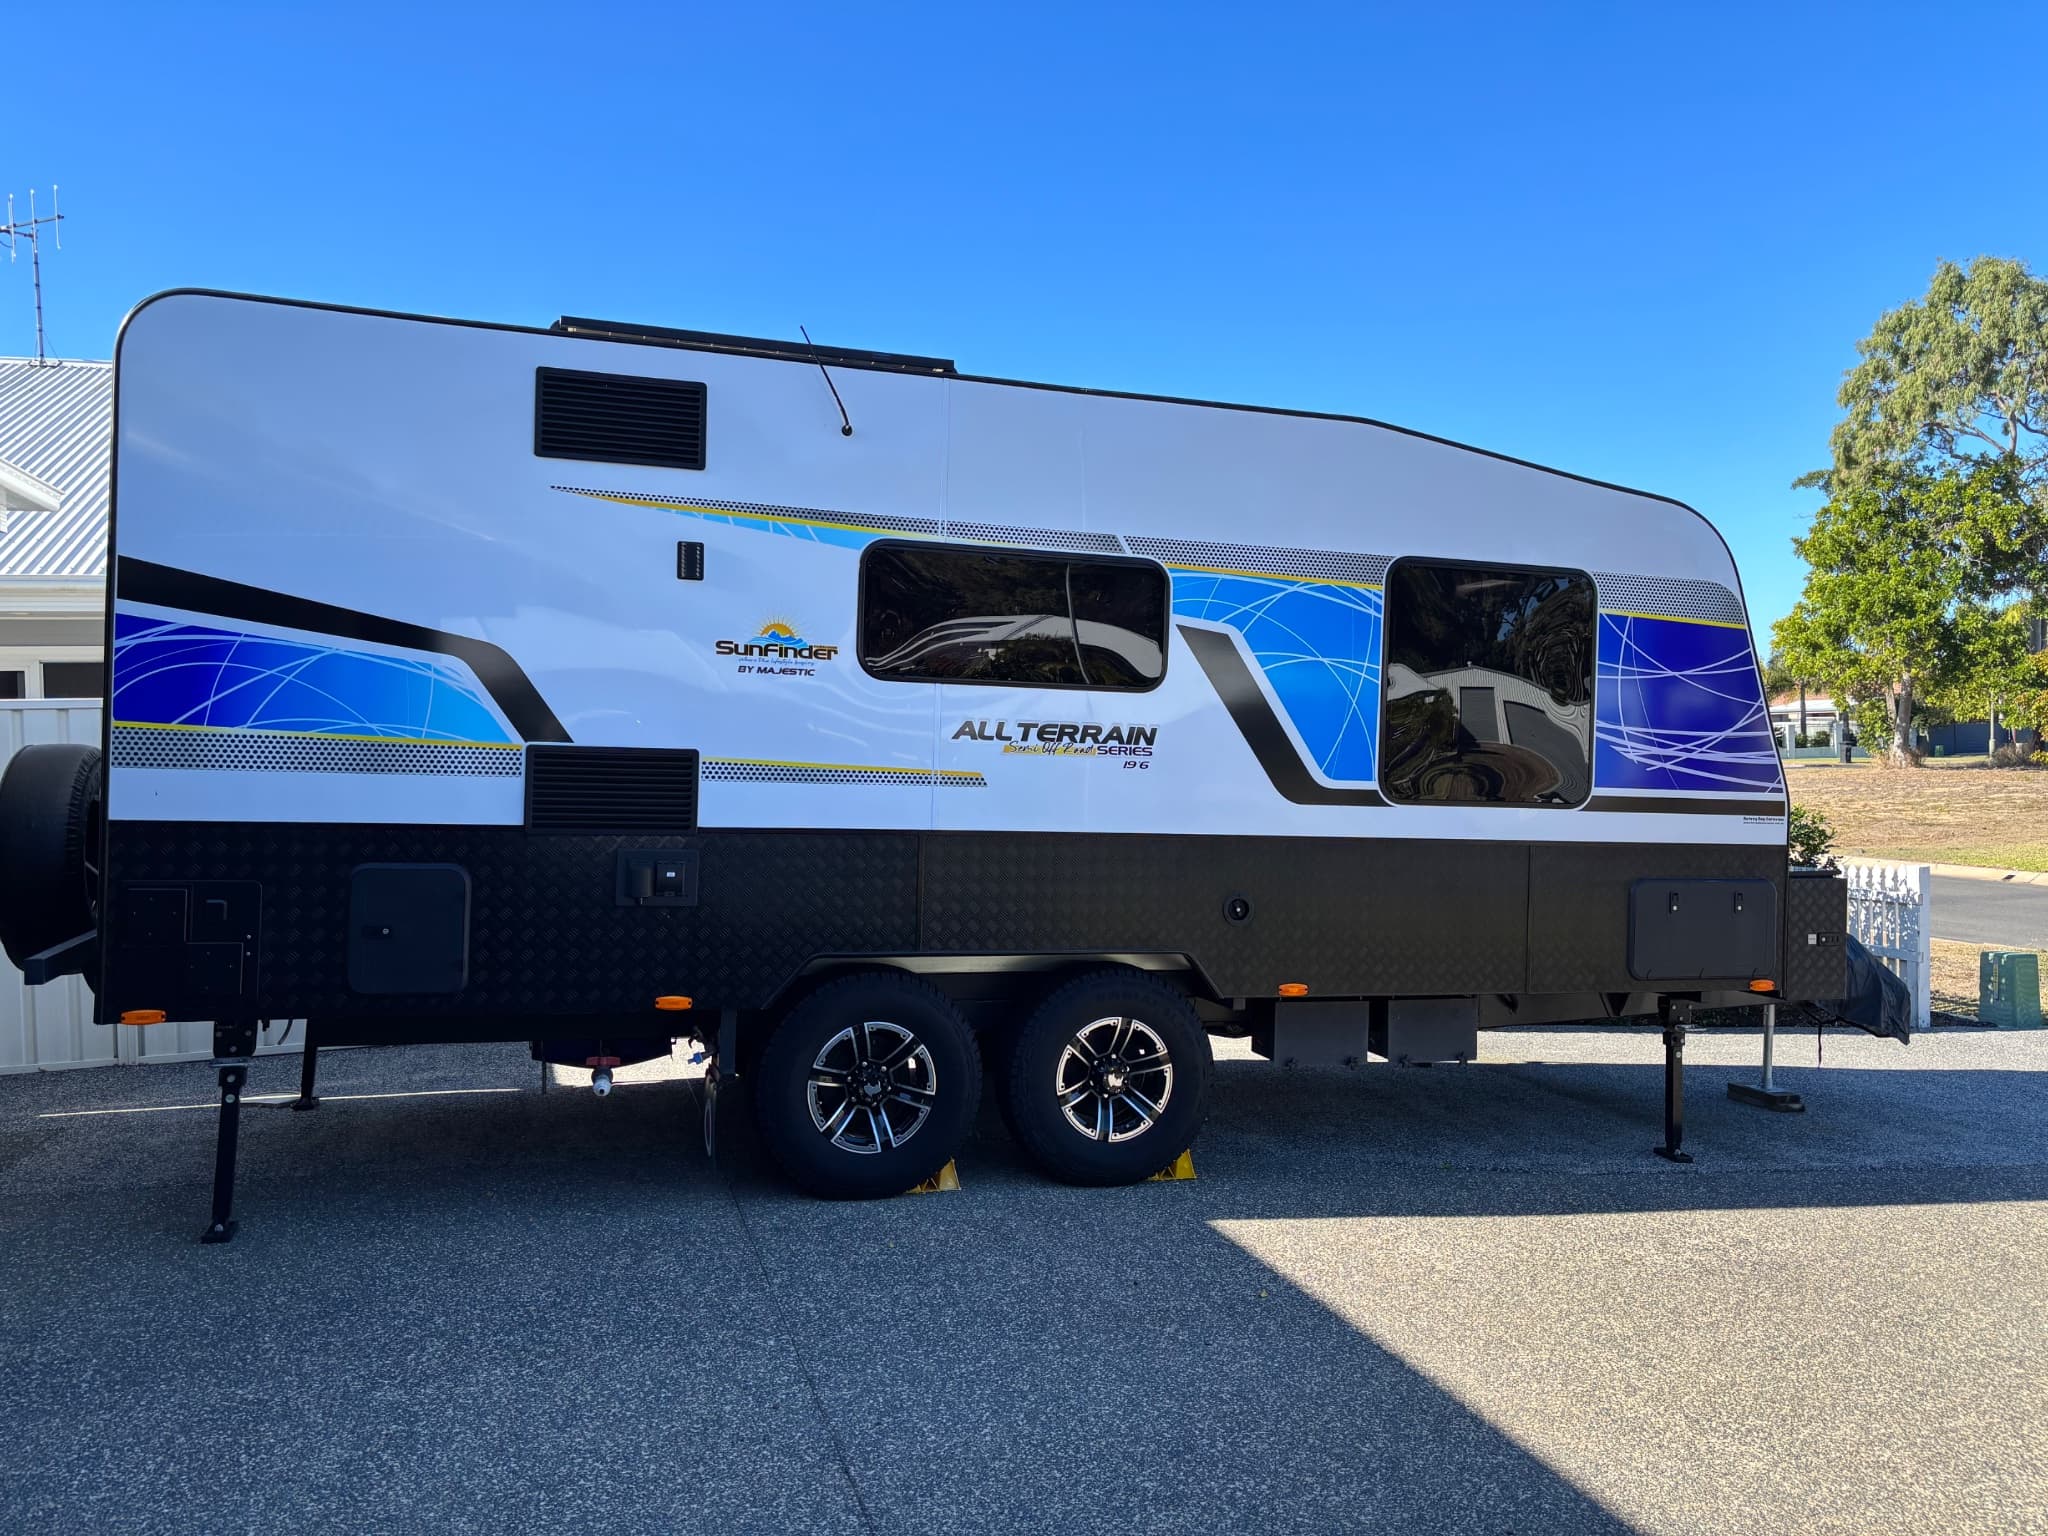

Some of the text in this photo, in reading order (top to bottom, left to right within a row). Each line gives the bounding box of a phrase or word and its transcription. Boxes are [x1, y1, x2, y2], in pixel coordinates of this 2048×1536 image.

[737, 665, 815, 677] BY MAJESTIC
[951, 720, 1158, 746] ALL TERRAIN
[1009, 740, 1153, 756] Semi Off Road SERIES
